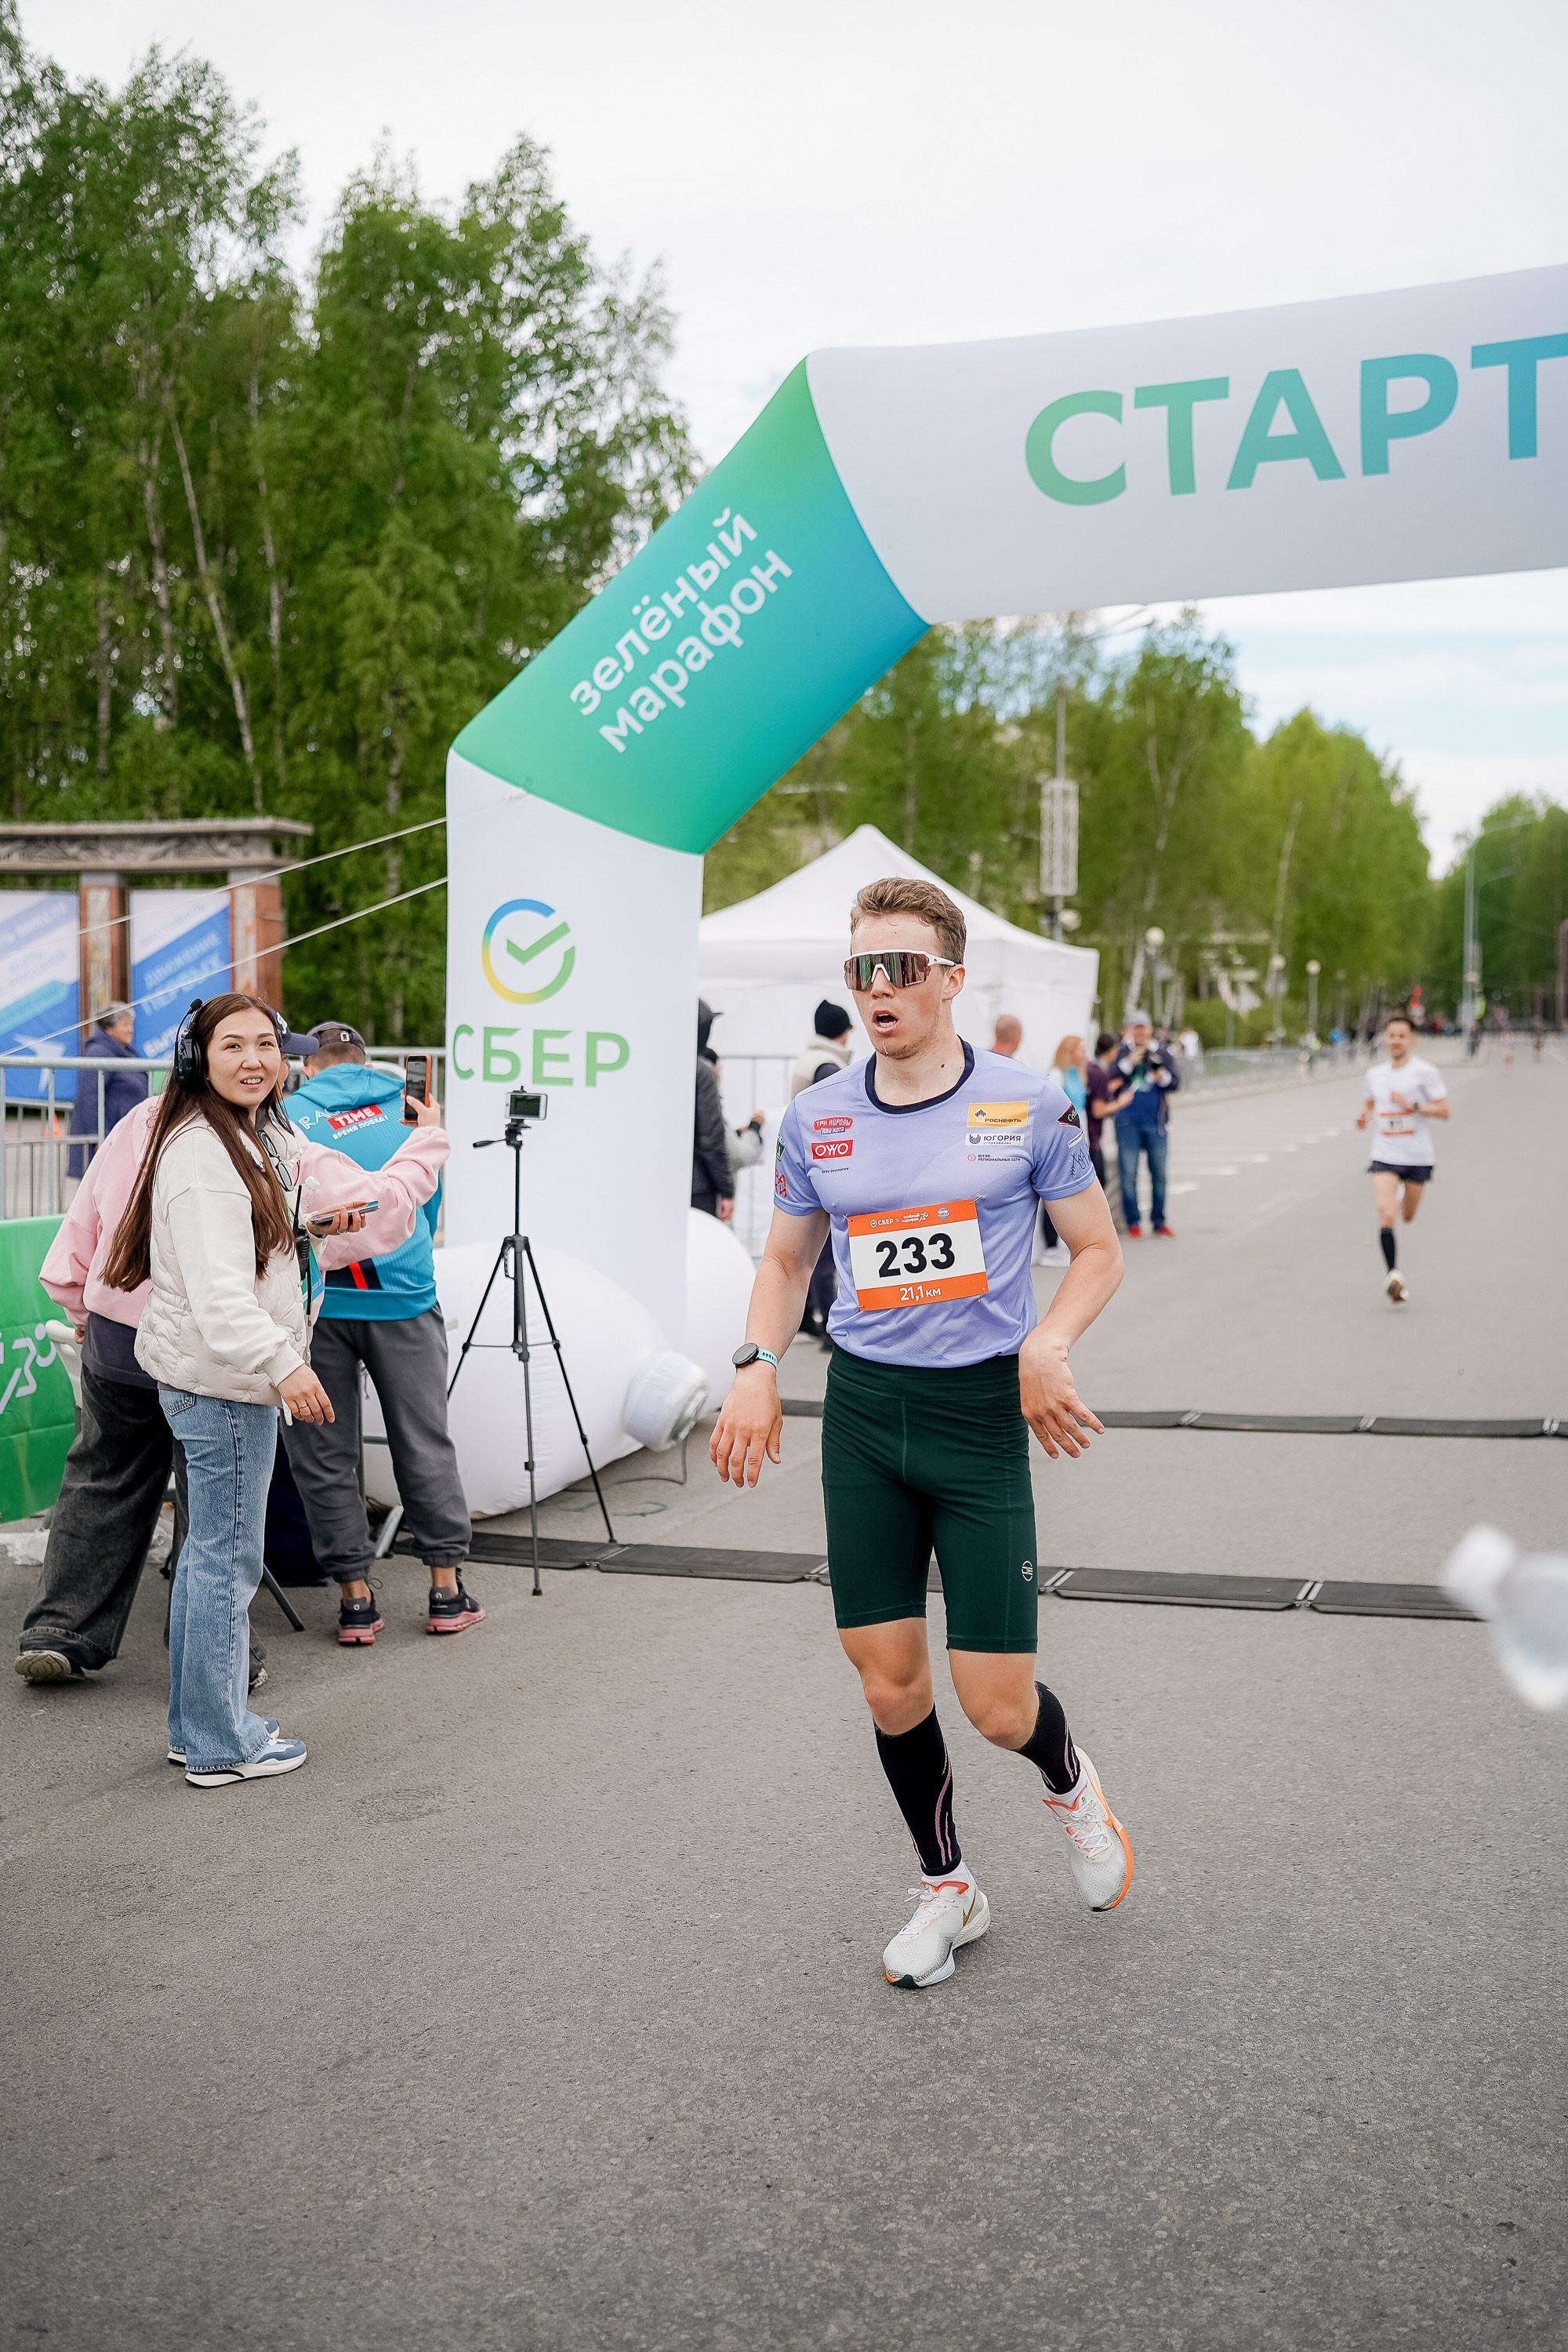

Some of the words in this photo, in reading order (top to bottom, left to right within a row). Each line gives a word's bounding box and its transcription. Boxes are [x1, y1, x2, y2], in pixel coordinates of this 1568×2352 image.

[1025, 333, 1568, 506] СТАРТ
[569, 506, 758, 716] зелёный
[598, 549, 793, 754] марафон
[452, 1024, 631, 1088] СБЕР
[298, 1108, 351, 1130] RA
[332, 1126, 359, 1141] ВРЕМЯ
[334, 1108, 375, 1127] TIME
[876, 1232, 955, 1278] 233
